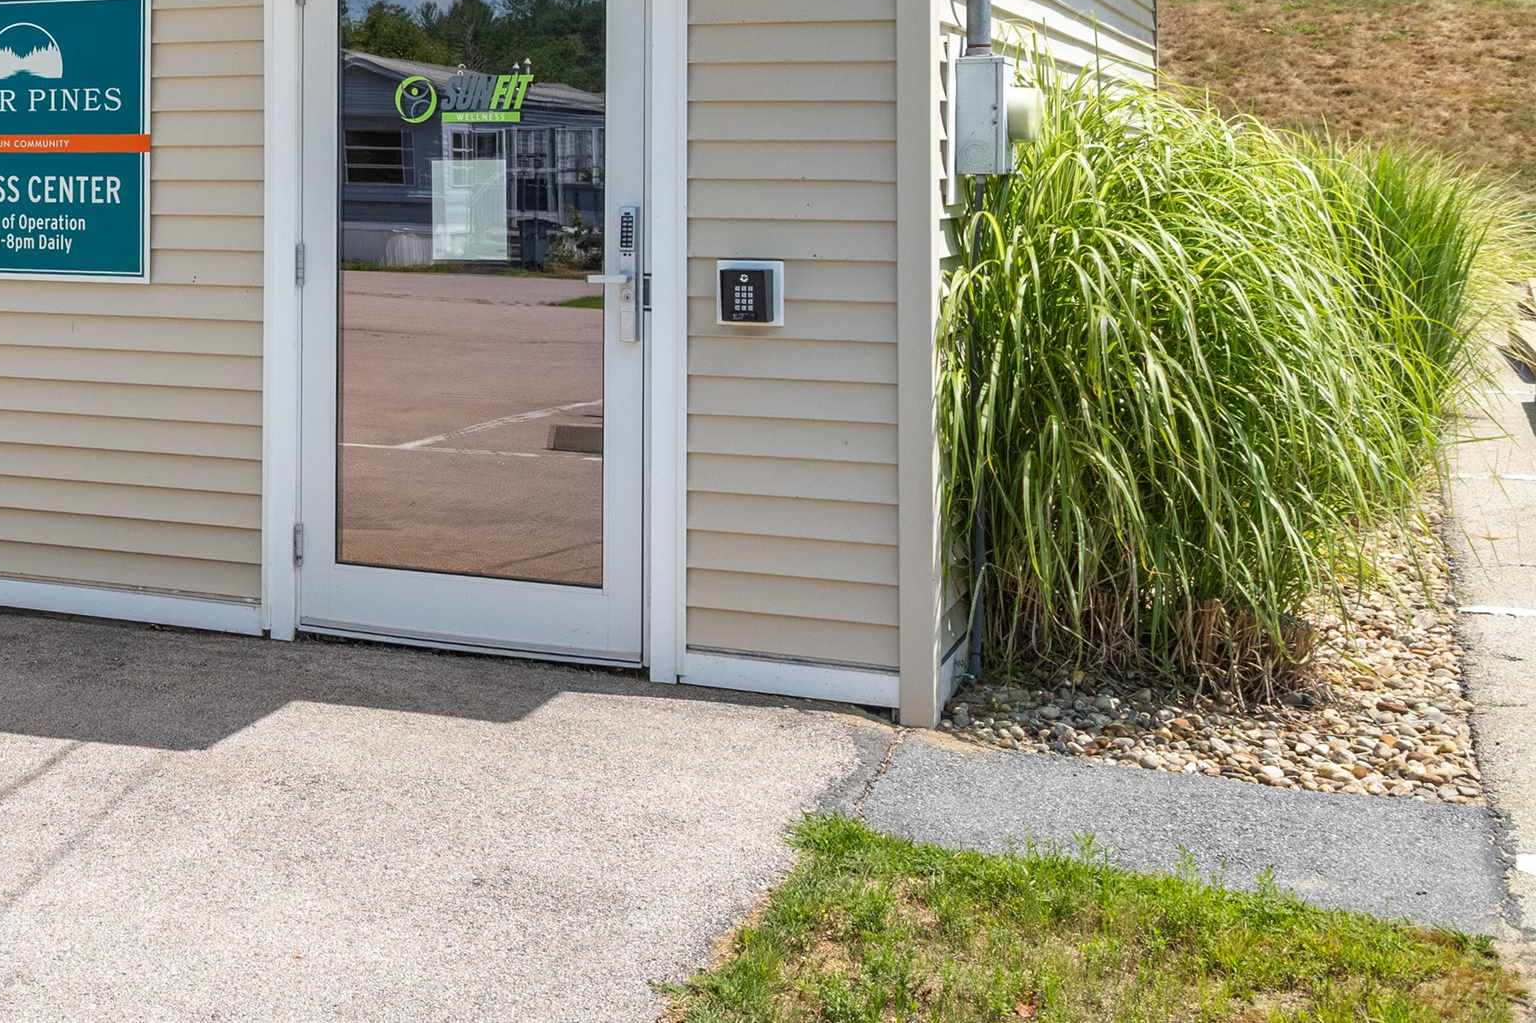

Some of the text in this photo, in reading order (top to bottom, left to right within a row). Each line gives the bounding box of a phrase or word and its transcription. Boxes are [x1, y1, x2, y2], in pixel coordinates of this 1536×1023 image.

[28, 87, 122, 112] PINES
[456, 112, 505, 121] WELLNESS
[14, 139, 70, 148] COMMUNITY
[28, 175, 121, 204] CENTER
[2, 214, 15, 230] of
[18, 214, 86, 233] Operation
[39, 234, 72, 254] Daily
